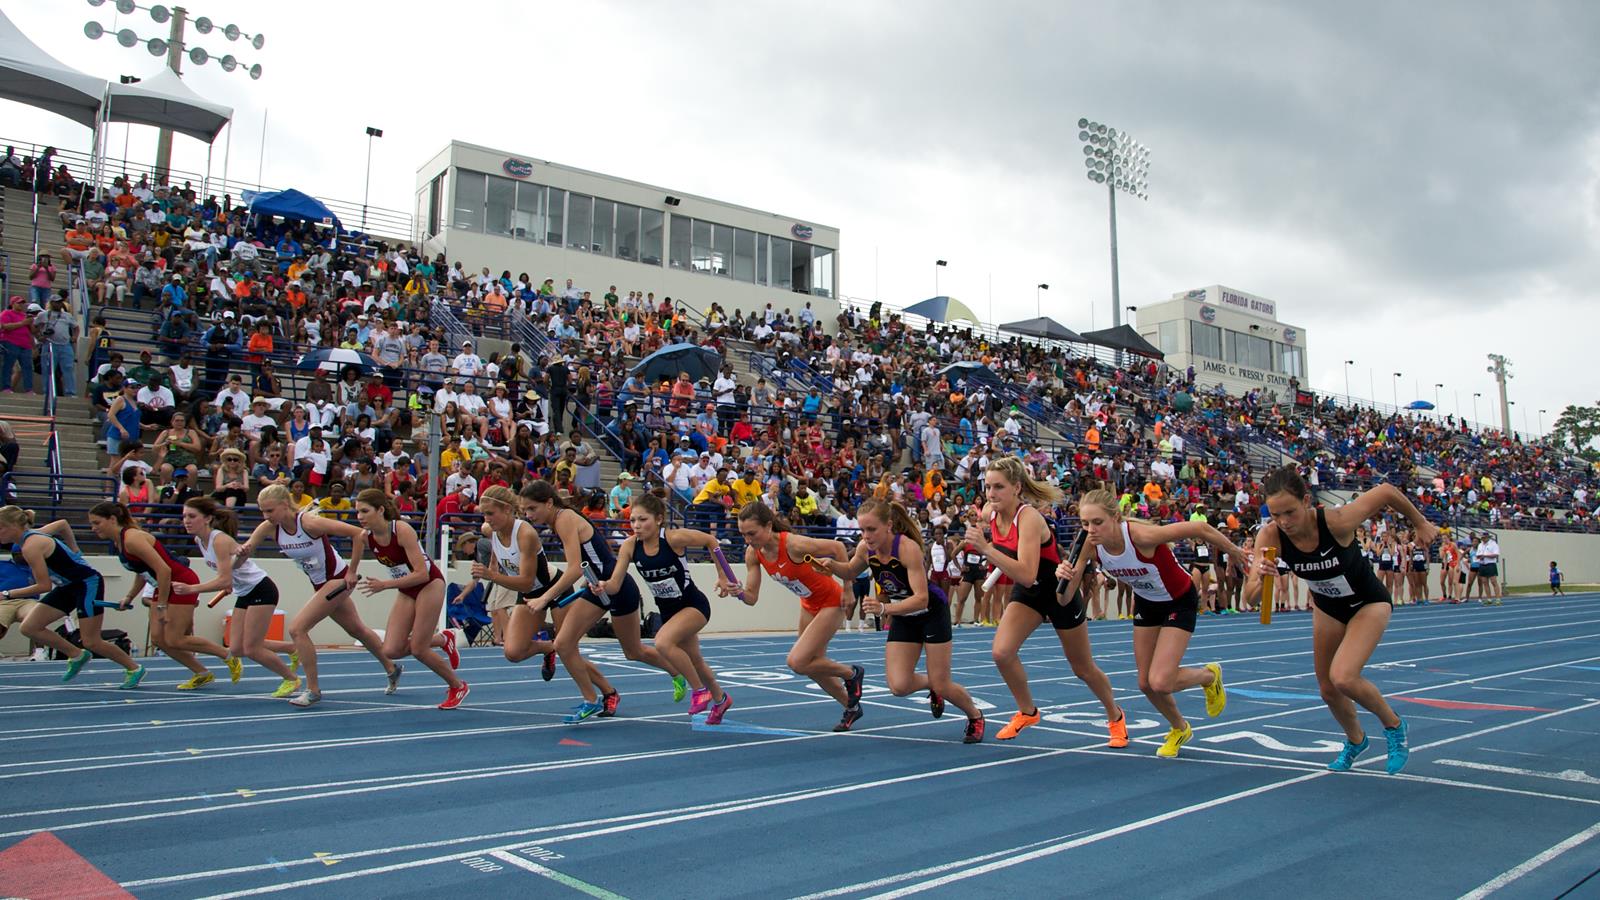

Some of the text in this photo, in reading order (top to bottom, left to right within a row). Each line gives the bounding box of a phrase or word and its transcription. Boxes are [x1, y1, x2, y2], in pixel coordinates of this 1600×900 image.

[1222, 291, 1274, 315] FLORIDA GATORS
[1203, 360, 1226, 374] JAMES
[1239, 367, 1265, 381] PRESSLY
[640, 564, 678, 578] UTSA
[1294, 556, 1340, 571] FLORIDA
[1201, 731, 1346, 753] 2
